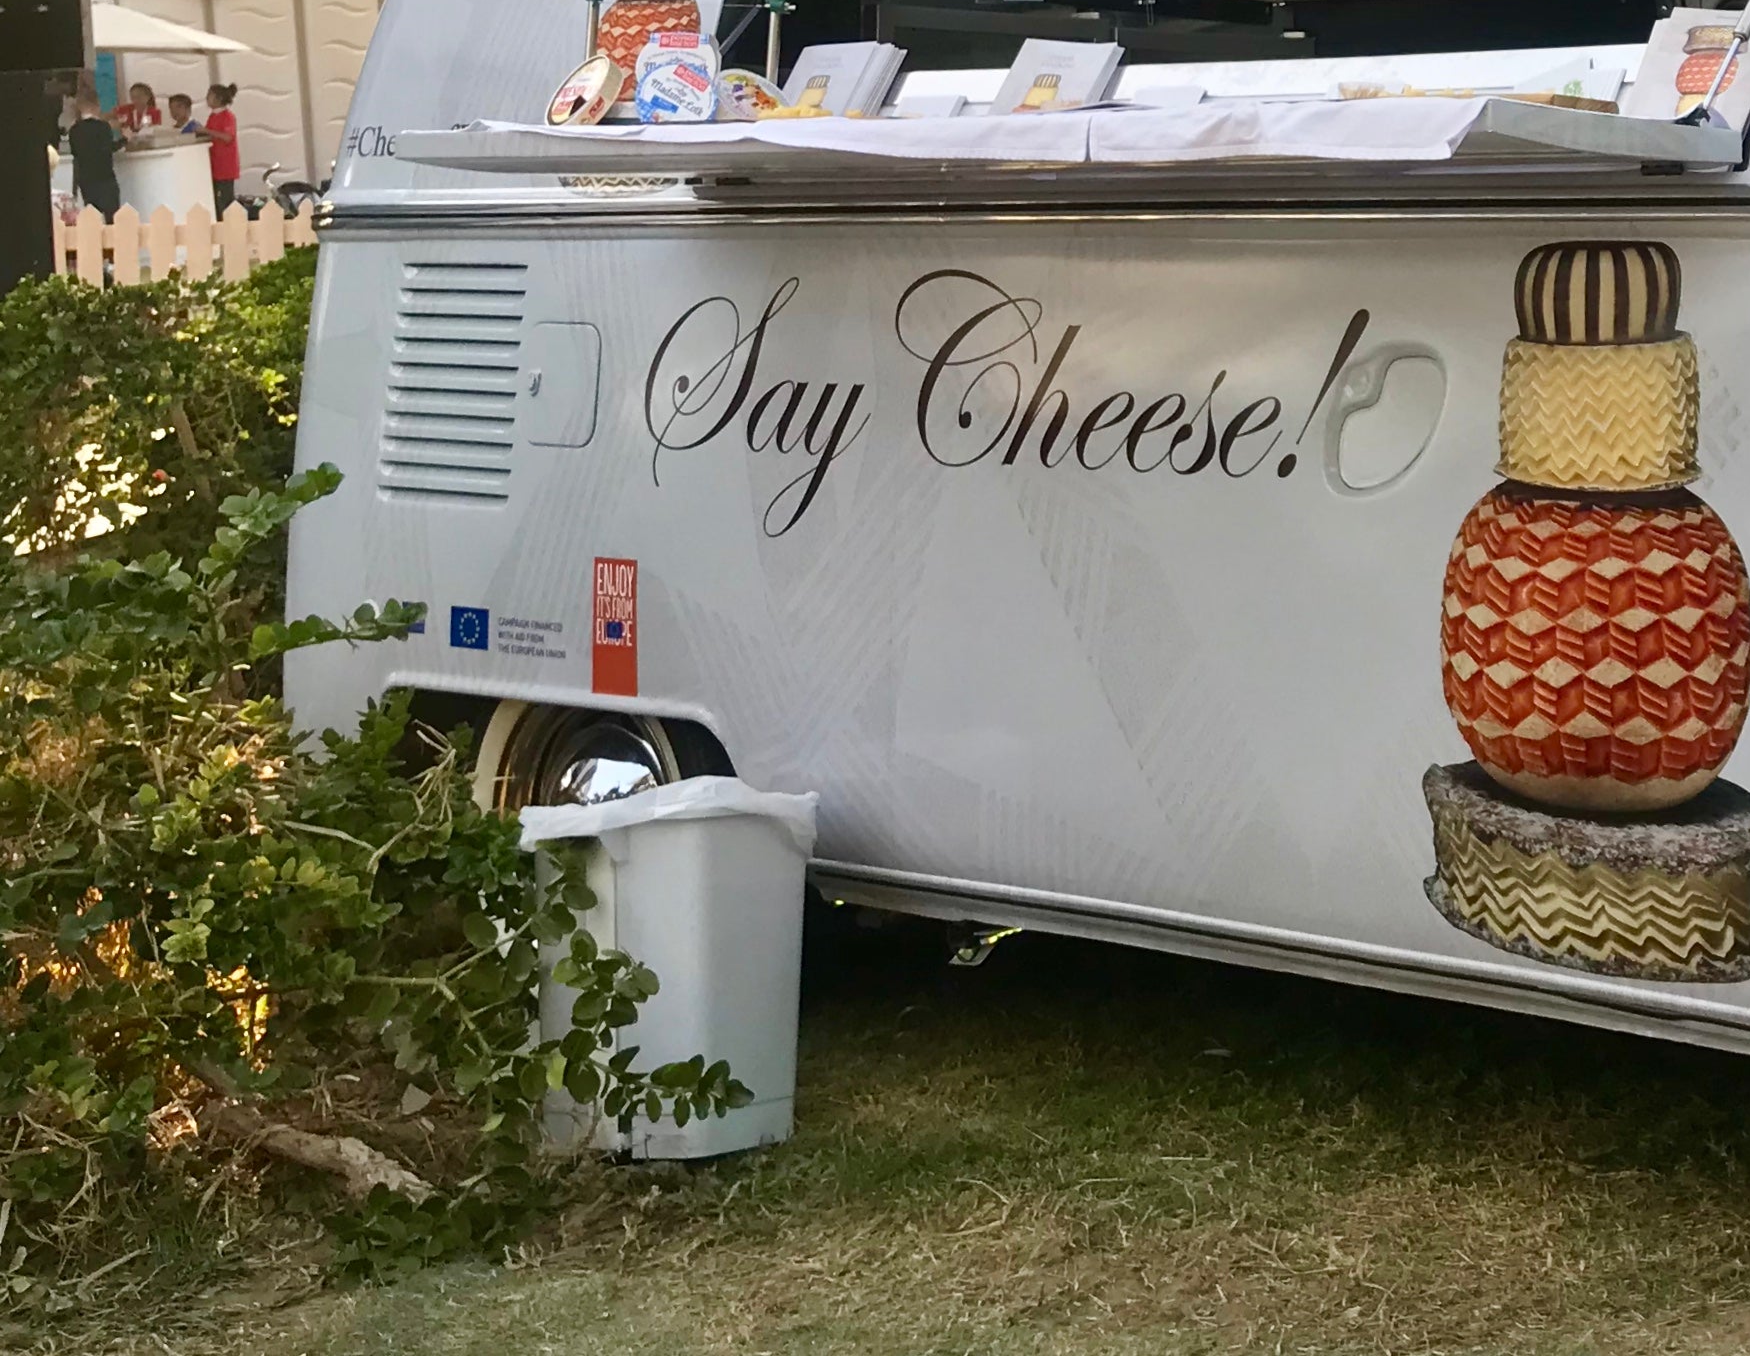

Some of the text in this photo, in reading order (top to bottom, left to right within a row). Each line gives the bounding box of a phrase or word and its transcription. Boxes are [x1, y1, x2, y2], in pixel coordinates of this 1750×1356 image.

[347, 125, 397, 157] #Che
[645, 269, 1371, 538] Say Cheese!
[597, 563, 634, 598] ENJOY
[612, 597, 633, 620] FROM
[511, 644, 545, 657] EUROPEAN
